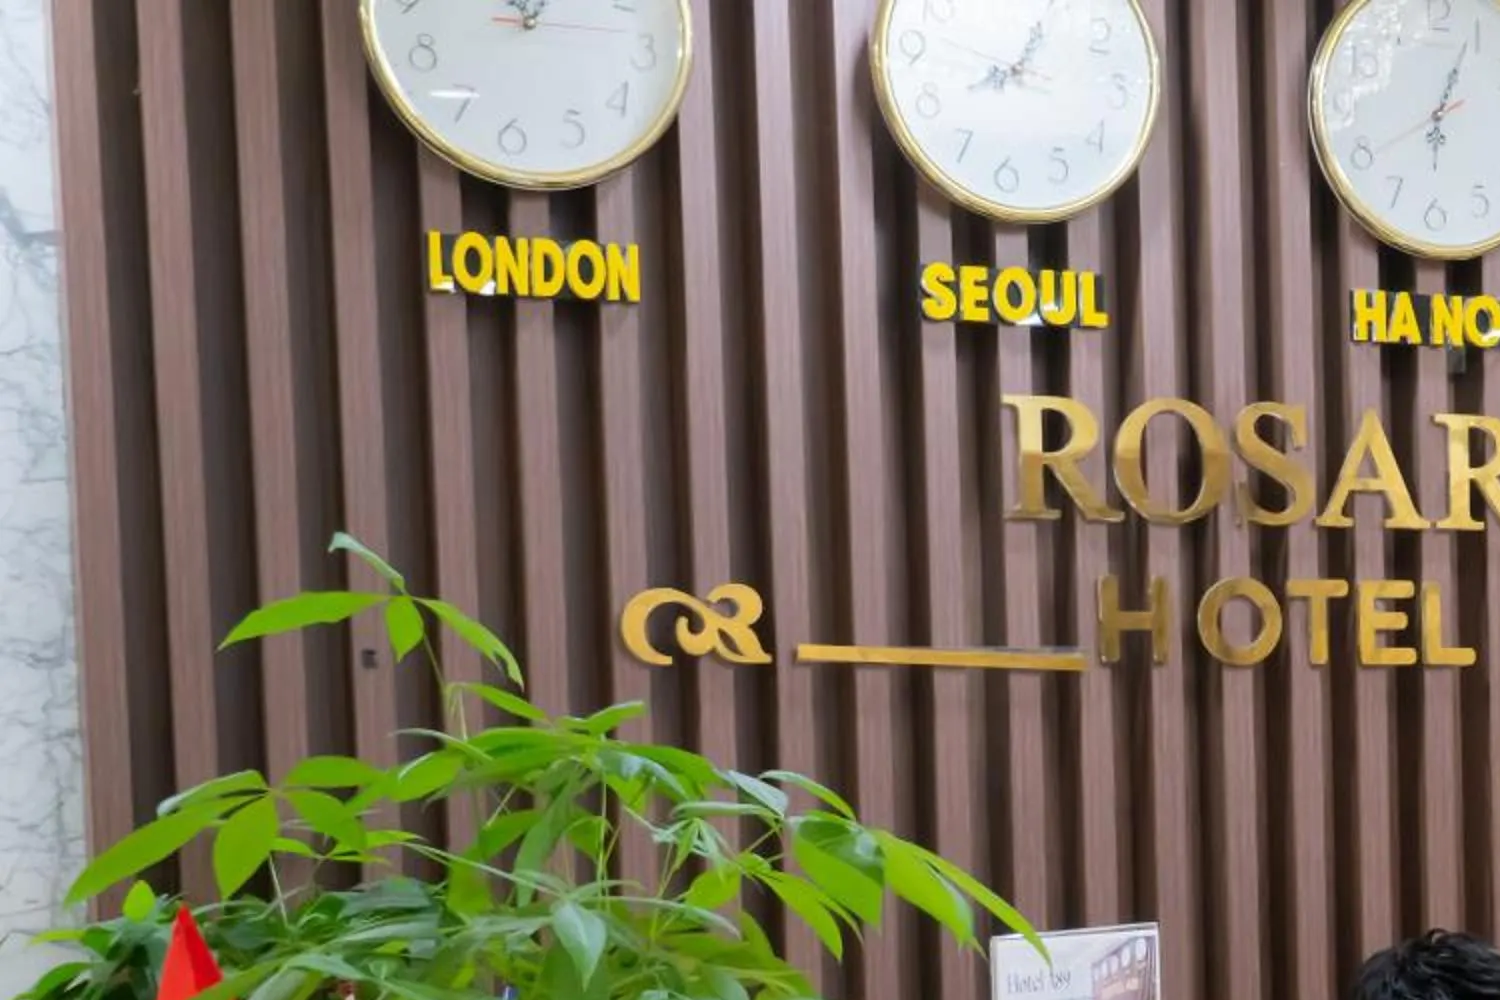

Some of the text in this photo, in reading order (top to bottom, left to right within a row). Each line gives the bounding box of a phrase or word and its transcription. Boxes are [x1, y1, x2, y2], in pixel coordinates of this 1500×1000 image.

[1427, 0, 1451, 31] 12
[408, 33, 437, 72] 8
[630, 33, 656, 72] 3
[899, 29, 926, 65] 9
[1089, 17, 1112, 55] 2
[452, 83, 476, 123] 7
[606, 80, 629, 118] 4
[915, 81, 941, 119] 8
[497, 118, 527, 156] 6
[561, 109, 585, 149] 5
[955, 128, 974, 163] 7
[1085, 120, 1104, 153] 4
[1047, 146, 1070, 184] 5
[1350, 135, 1374, 171] 8
[993, 156, 1020, 194] 6
[1386, 174, 1405, 209] 7
[1423, 197, 1447, 232] 6
[1472, 184, 1489, 219] 5
[427, 230, 641, 302] LONDON
[920, 261, 1110, 328] SEOUL
[1352, 288, 1422, 345] HA
[1097, 576, 1477, 667] HOTEL
